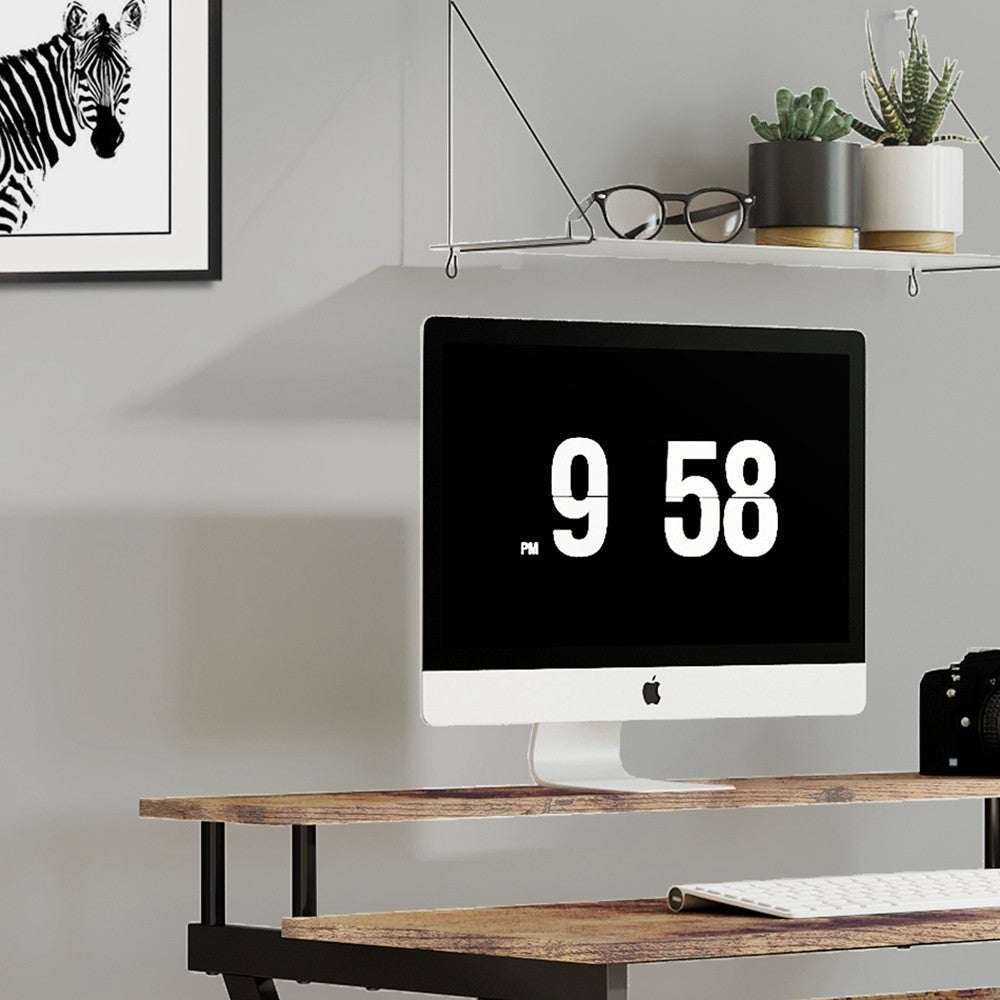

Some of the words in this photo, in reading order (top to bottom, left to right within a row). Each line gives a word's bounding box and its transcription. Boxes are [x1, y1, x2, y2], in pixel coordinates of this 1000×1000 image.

[520, 541, 539, 556] PM
[551, 437, 609, 558] 9
[664, 439, 779, 558] 58
